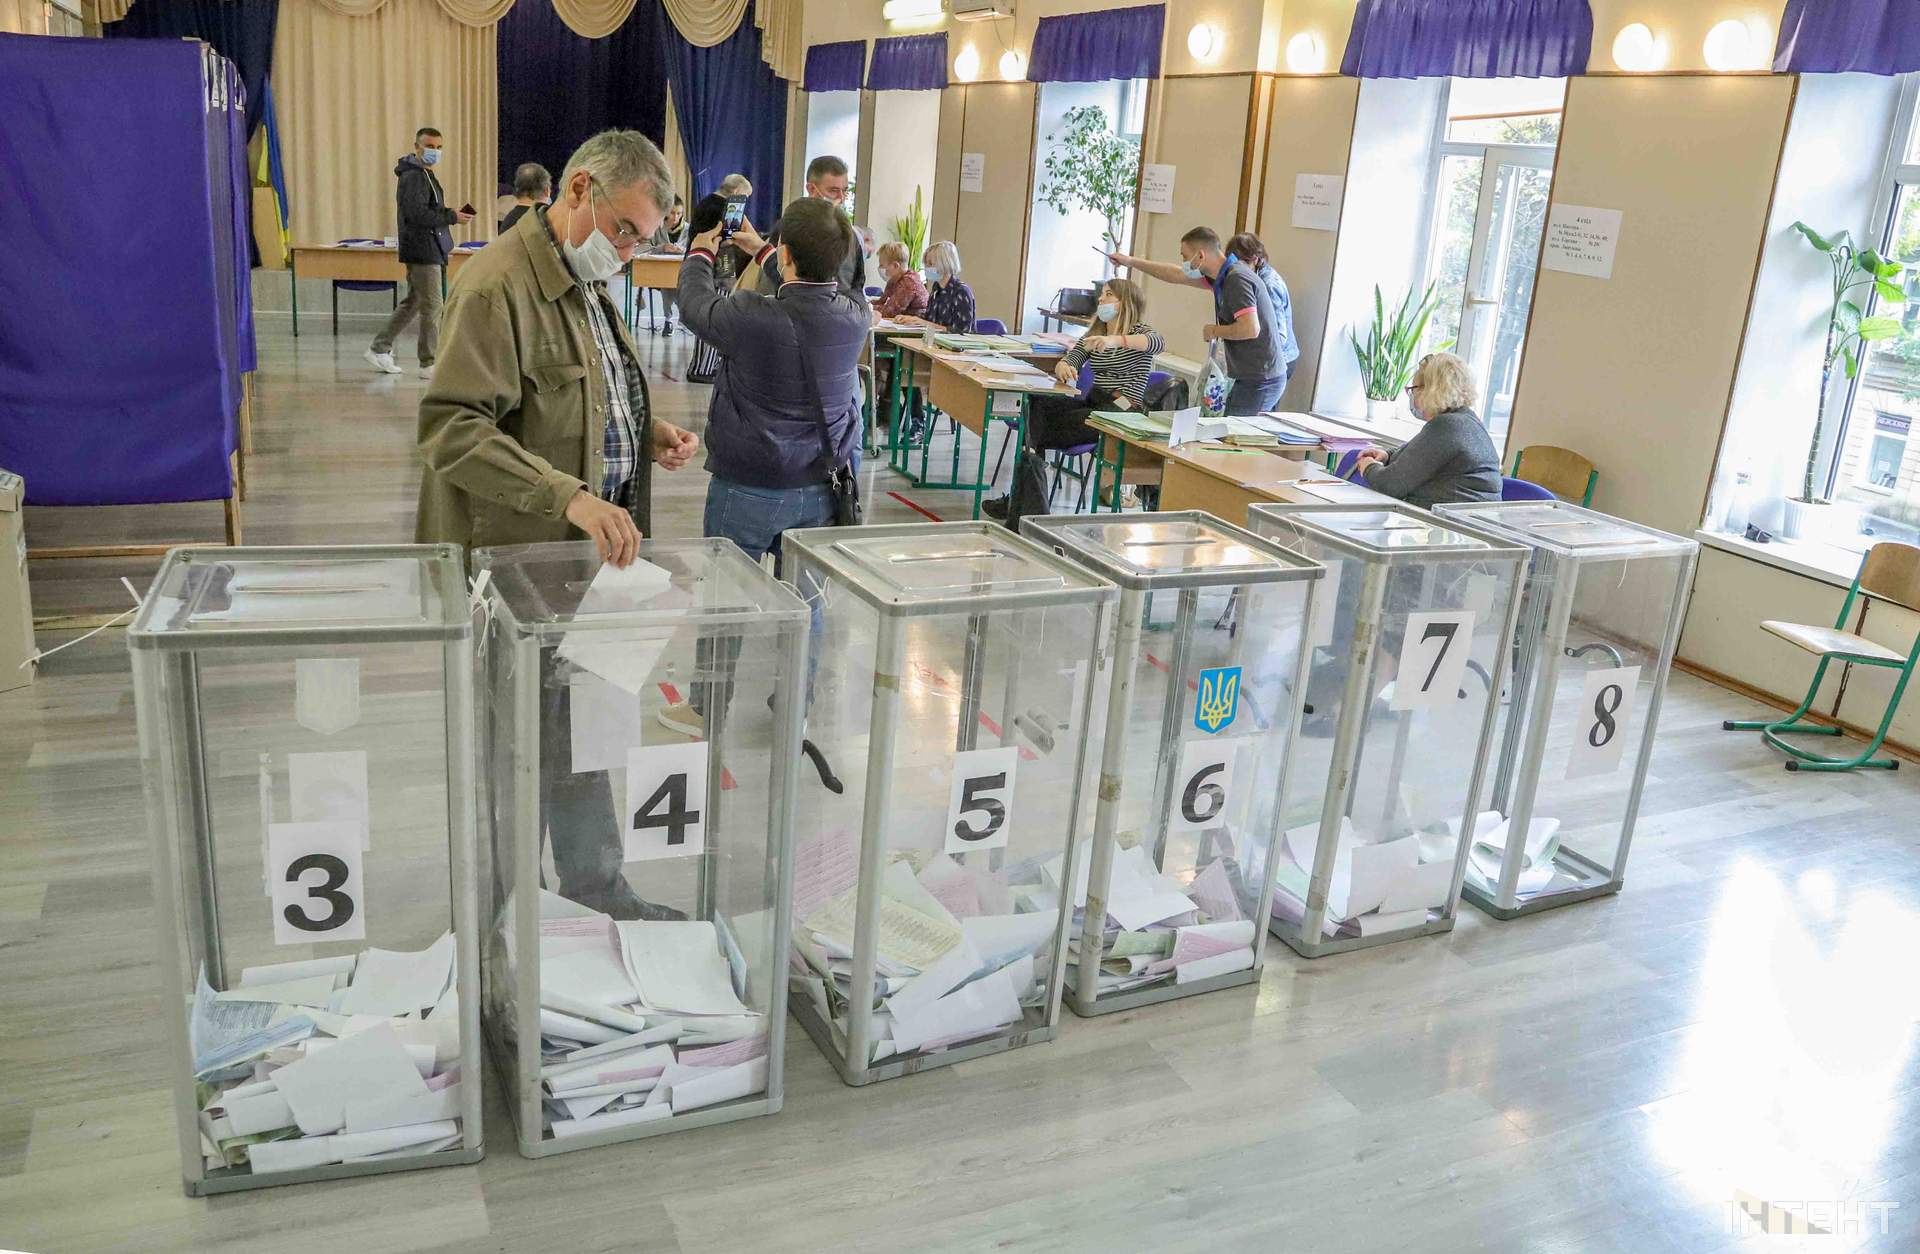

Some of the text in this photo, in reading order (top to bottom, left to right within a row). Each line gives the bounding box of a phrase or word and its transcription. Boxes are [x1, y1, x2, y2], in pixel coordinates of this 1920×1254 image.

[1420, 622, 1459, 692] 7
[1588, 684, 1623, 747] 8
[633, 773, 700, 845] 4
[953, 772, 1007, 842] 5
[1181, 762, 1225, 824] 6
[283, 854, 355, 932] 3
